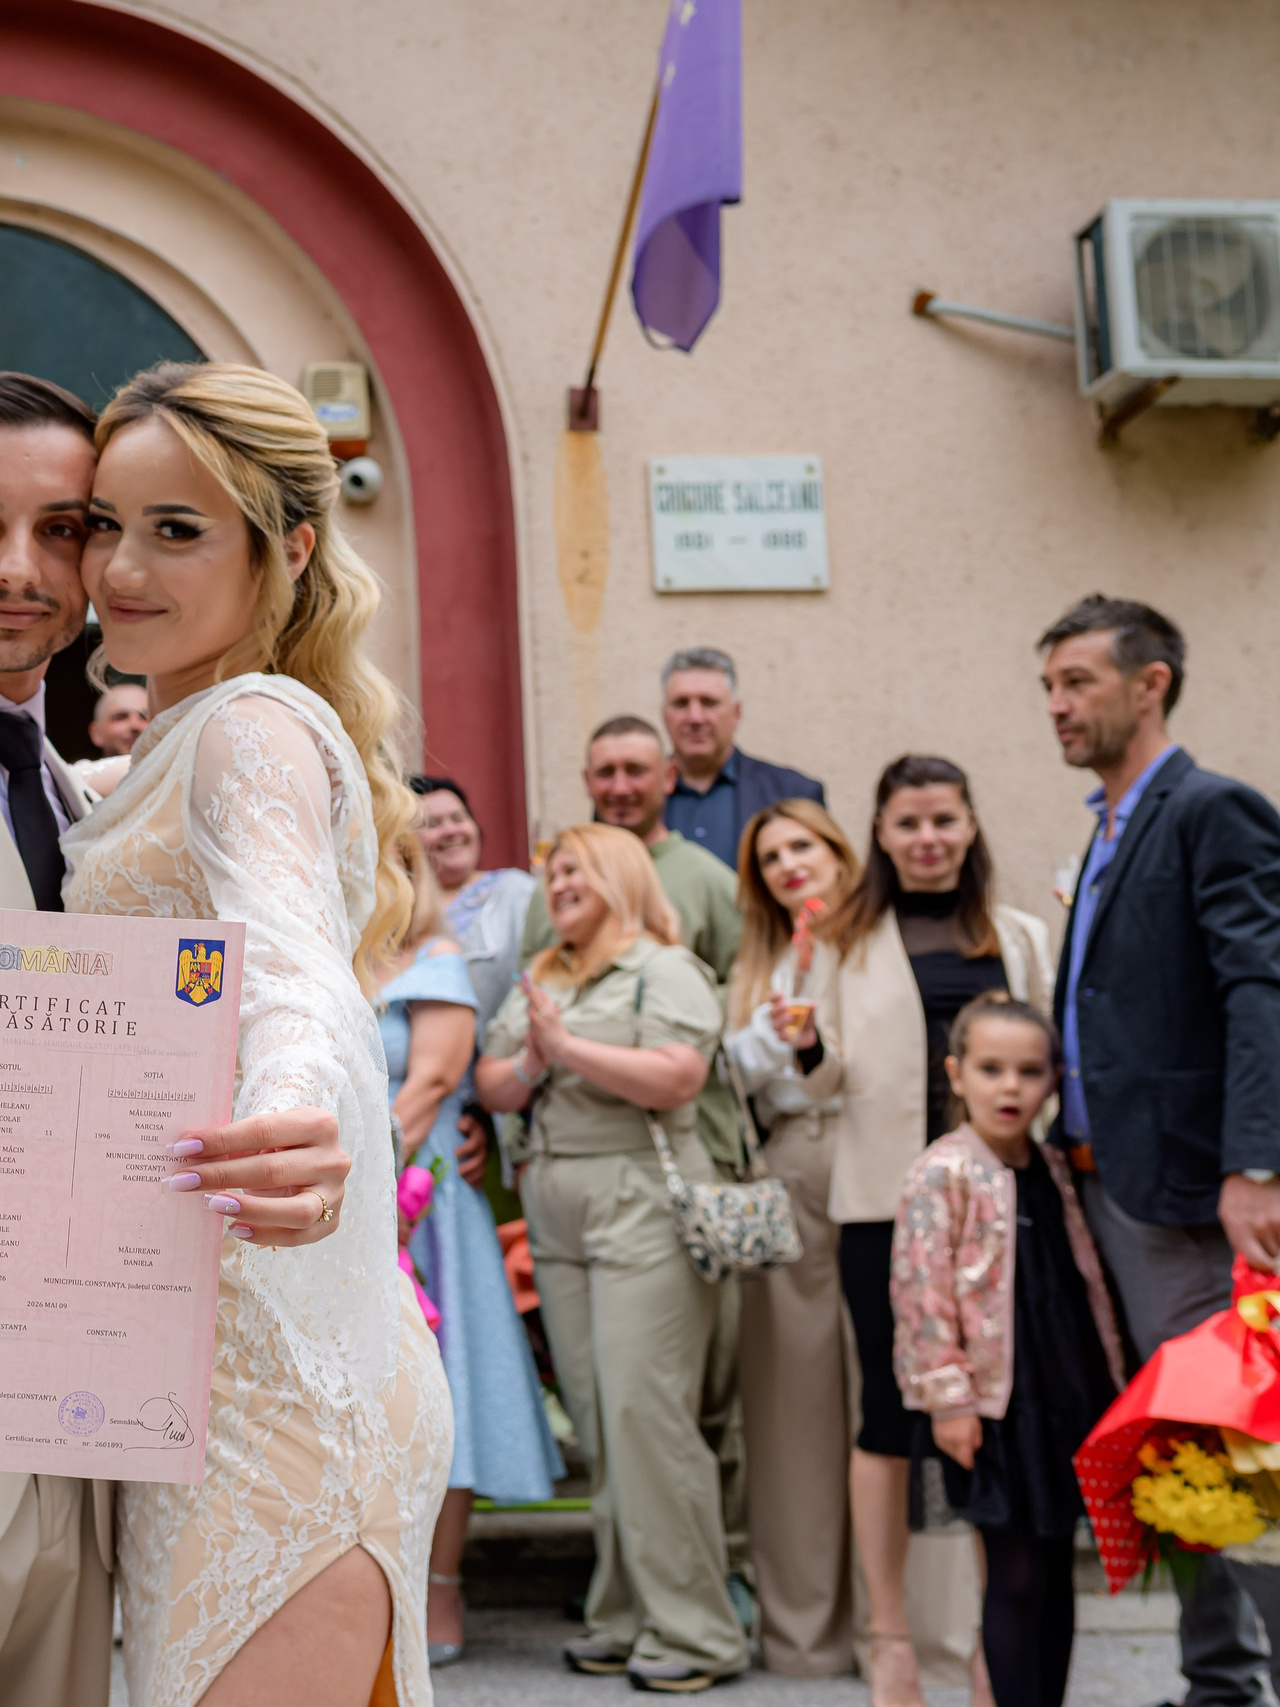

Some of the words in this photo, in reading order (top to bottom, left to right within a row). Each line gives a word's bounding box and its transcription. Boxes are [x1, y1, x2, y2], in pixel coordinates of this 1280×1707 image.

[129, 1109, 172, 1118] MĂLUREANU
[2, 1145, 25, 1153] MĂCIN
[106, 1152, 146, 1160] MUNICIPIUL
[118, 1246, 160, 1255] MĂLUREANU
[44, 1278, 83, 1286] MUNICIPIUL
[5, 1435, 33, 1443] Certificat
[95, 1441, 123, 1449] 2601893
